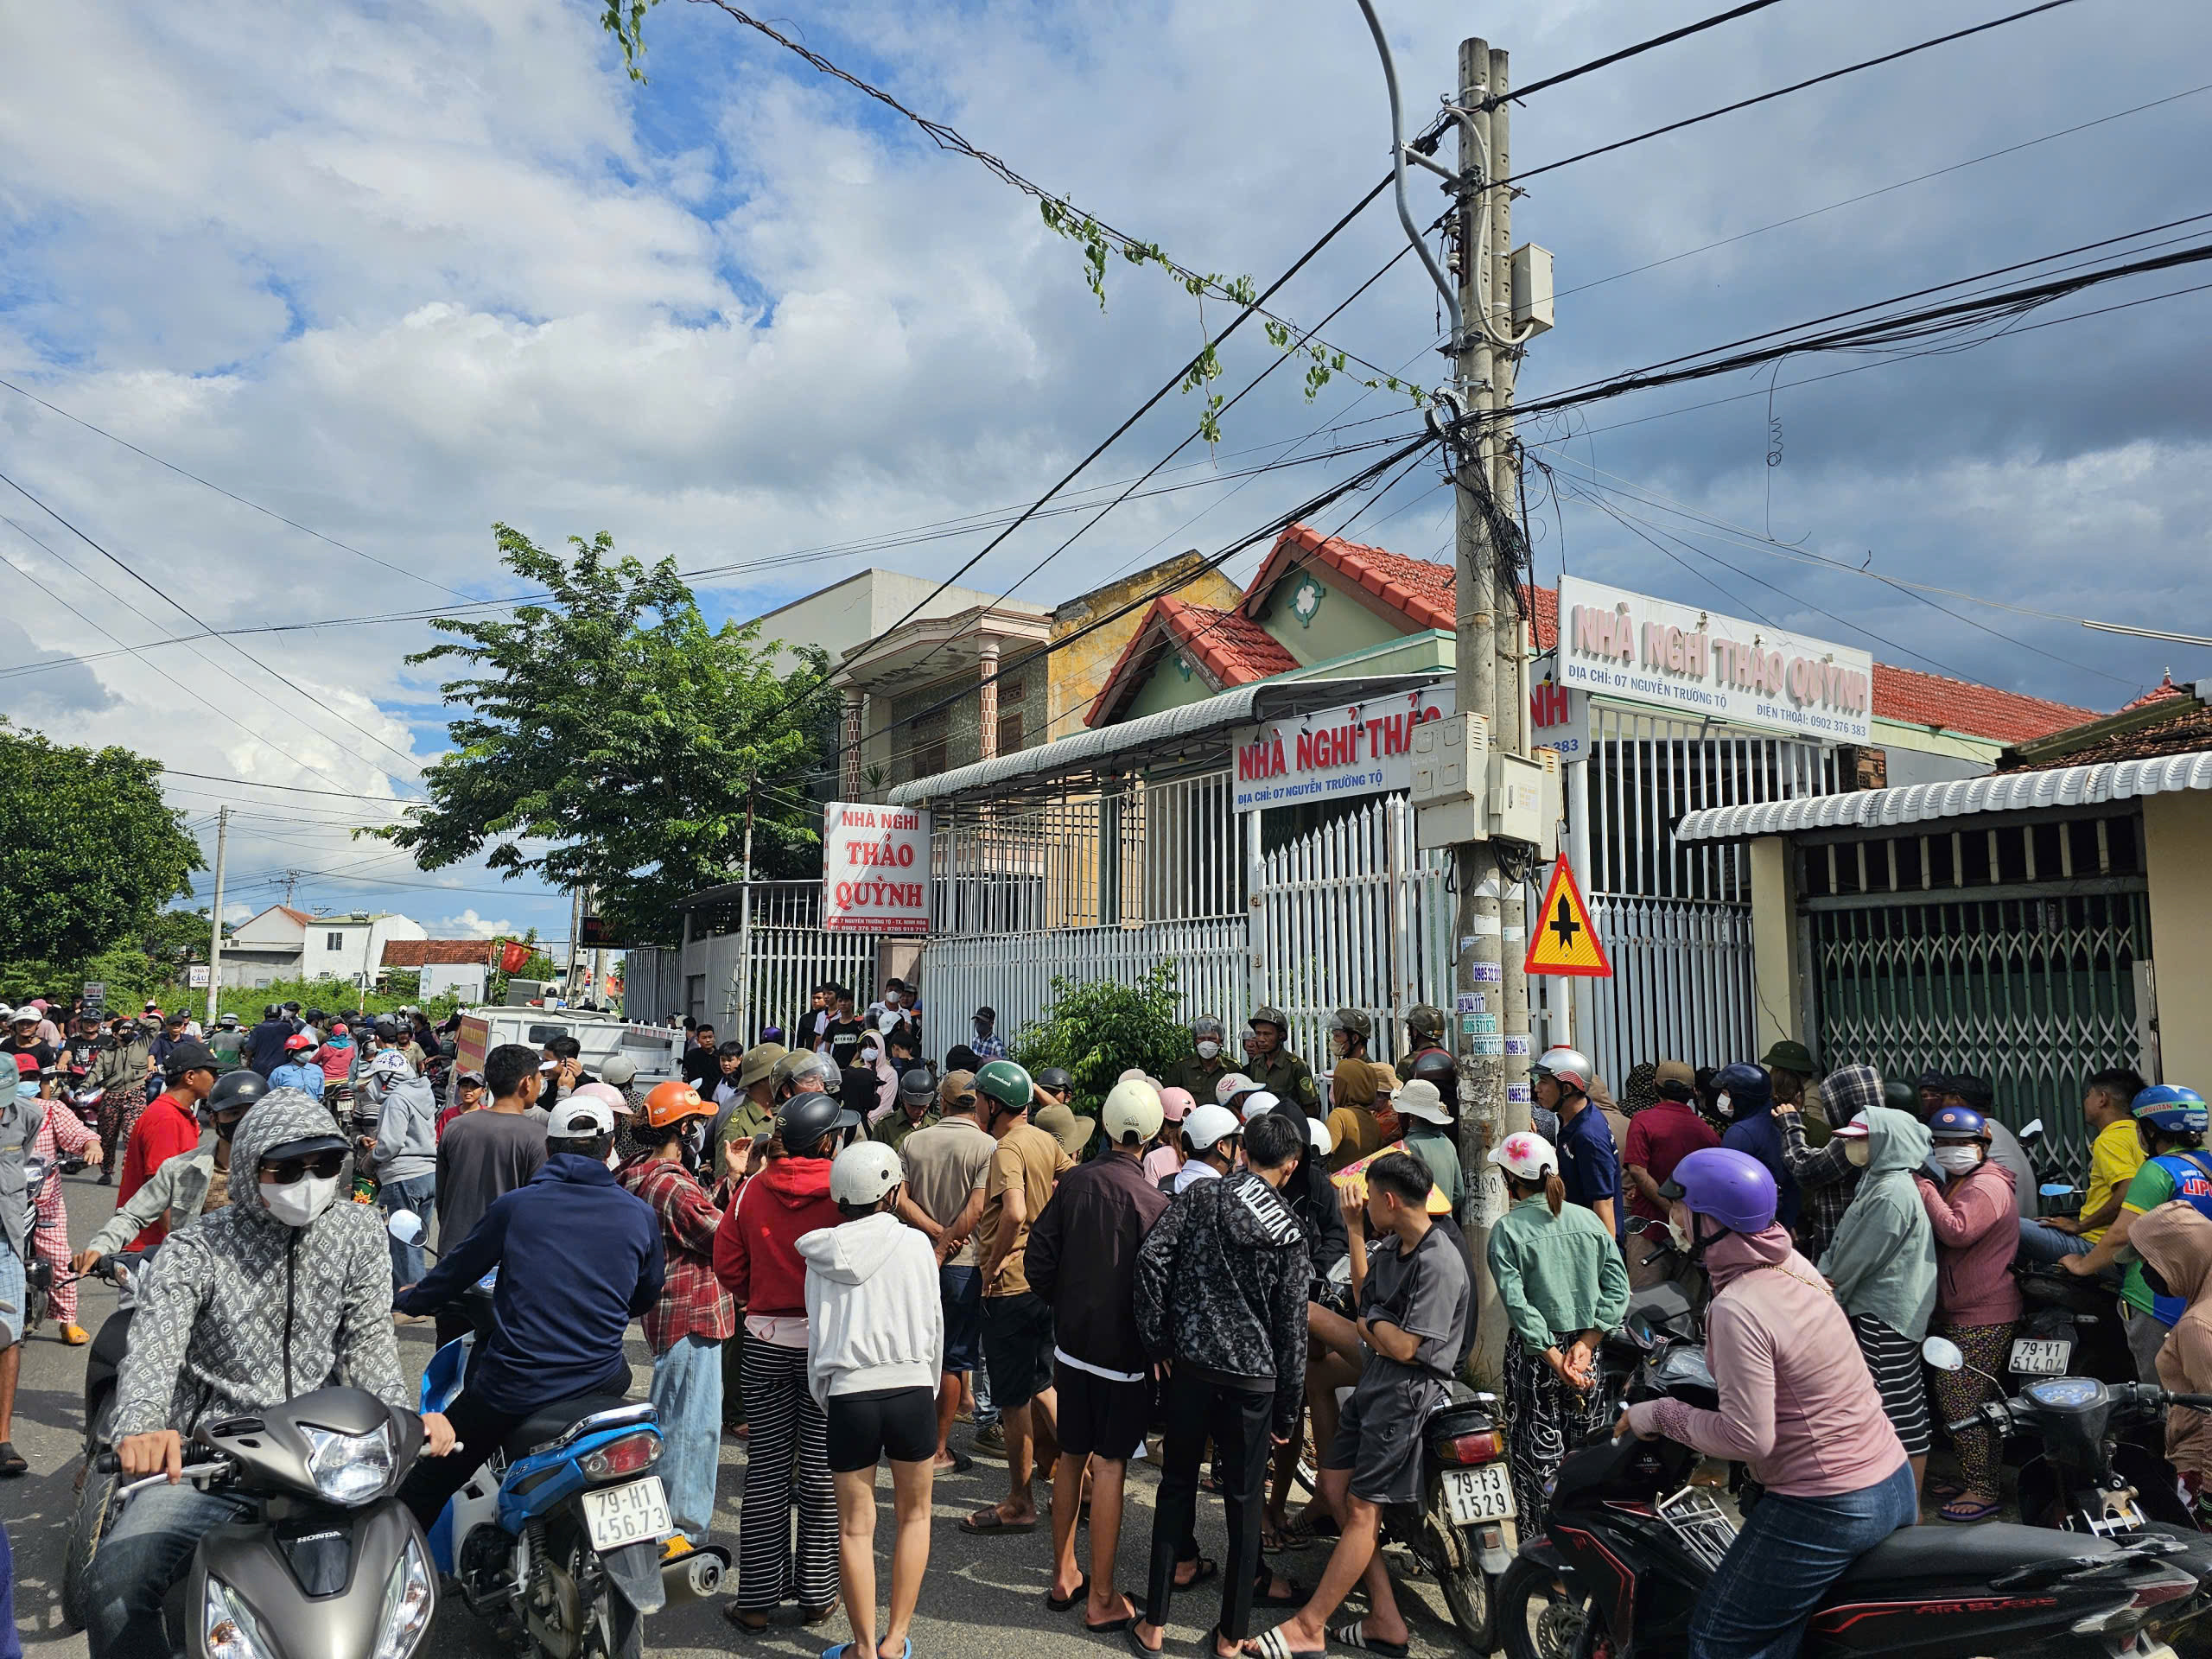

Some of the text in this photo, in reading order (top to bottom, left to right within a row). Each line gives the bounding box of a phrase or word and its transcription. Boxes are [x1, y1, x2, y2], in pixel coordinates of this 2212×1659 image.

[1573, 601, 1636, 663] NHÀ
[1787, 652, 1869, 714] QUỲNH
[1568, 664, 1727, 711] ĐỊA CHỈ: 07 NGUYỄN TRƯỜNG TỘ
[1757, 703, 1866, 737] ĐIỆN THOẠI: 0902 376 383
[1238, 728, 1287, 781] NHÀ
[1296, 707, 1359, 772] NGHỈ
[1237, 772, 1382, 804] ĐỊA CHỈ: 07 NGUYỄN TRƯỜNG TỘ
[842, 810, 919, 830] NHÀ NGHỈ
[845, 832, 915, 868] THẢO
[835, 875, 924, 911] QUỲNH
[1475, 996, 1484, 1013] 117
[2140, 1103, 2172, 1115] LIPOVITAN
[1233, 1177, 1292, 1240] VUITTON
[2020, 1342, 2061, 1357] 79-V1
[1452, 1469, 1500, 1496] 79-F3
[596, 1484, 652, 1517] 79-H1
[1459, 1492, 1506, 1520] 1529
[296, 1531, 342, 1543] HONDA
[597, 1507, 666, 1544] 456.73
[1915, 1598, 2057, 1614] AIR BLADE
